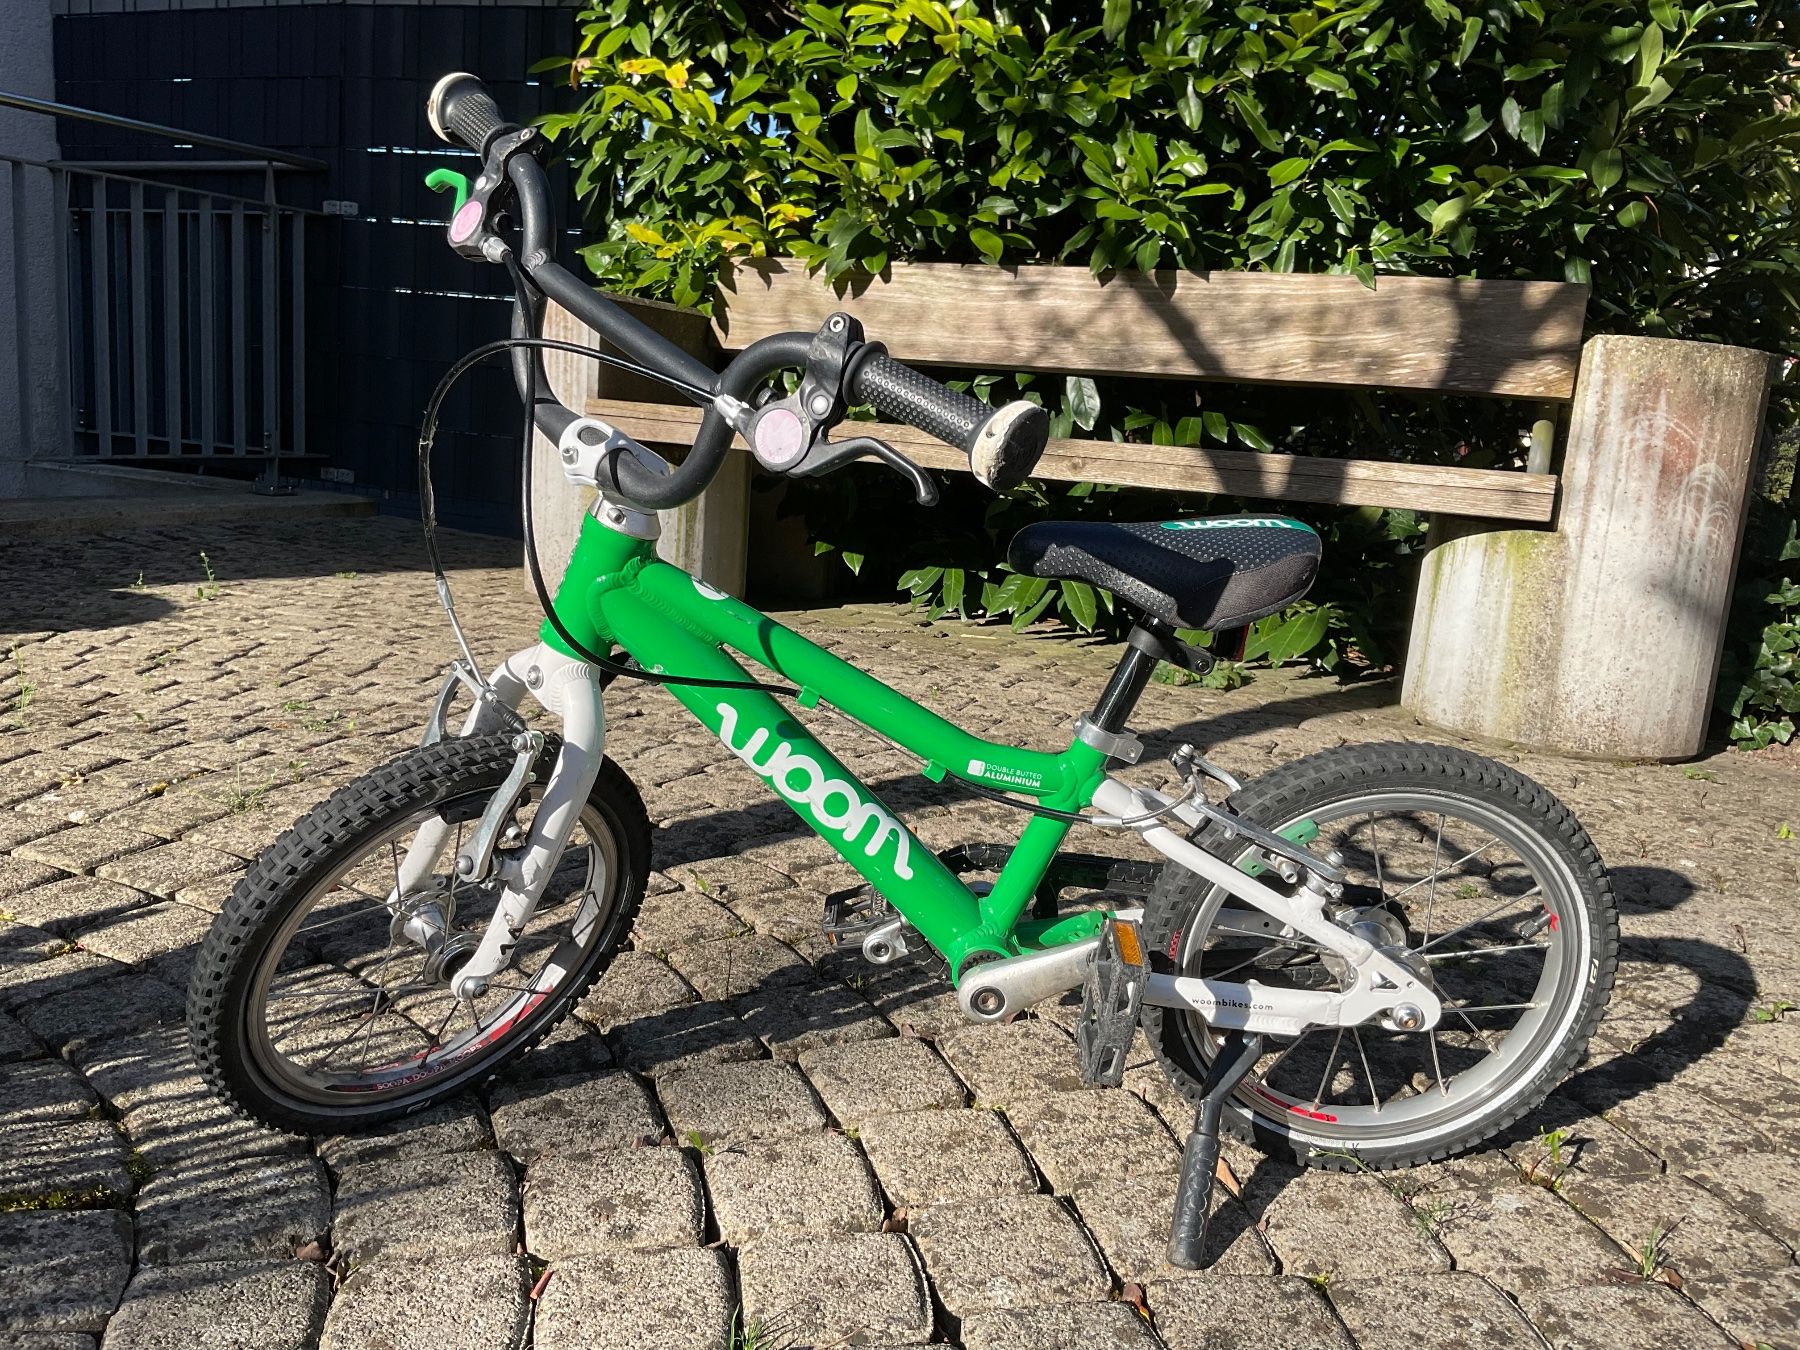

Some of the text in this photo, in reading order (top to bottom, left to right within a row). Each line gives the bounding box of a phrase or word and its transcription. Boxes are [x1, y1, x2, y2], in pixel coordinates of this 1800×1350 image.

[1173, 518, 1293, 529] woom
[983, 770, 1041, 788] ALUMINIUM
[986, 763, 1042, 780] DOUBLE BUTTED
[716, 702, 914, 880] woom
[1191, 997, 1274, 1012] woombikes.com
[1522, 985, 1594, 1096] LITTLE JOE
